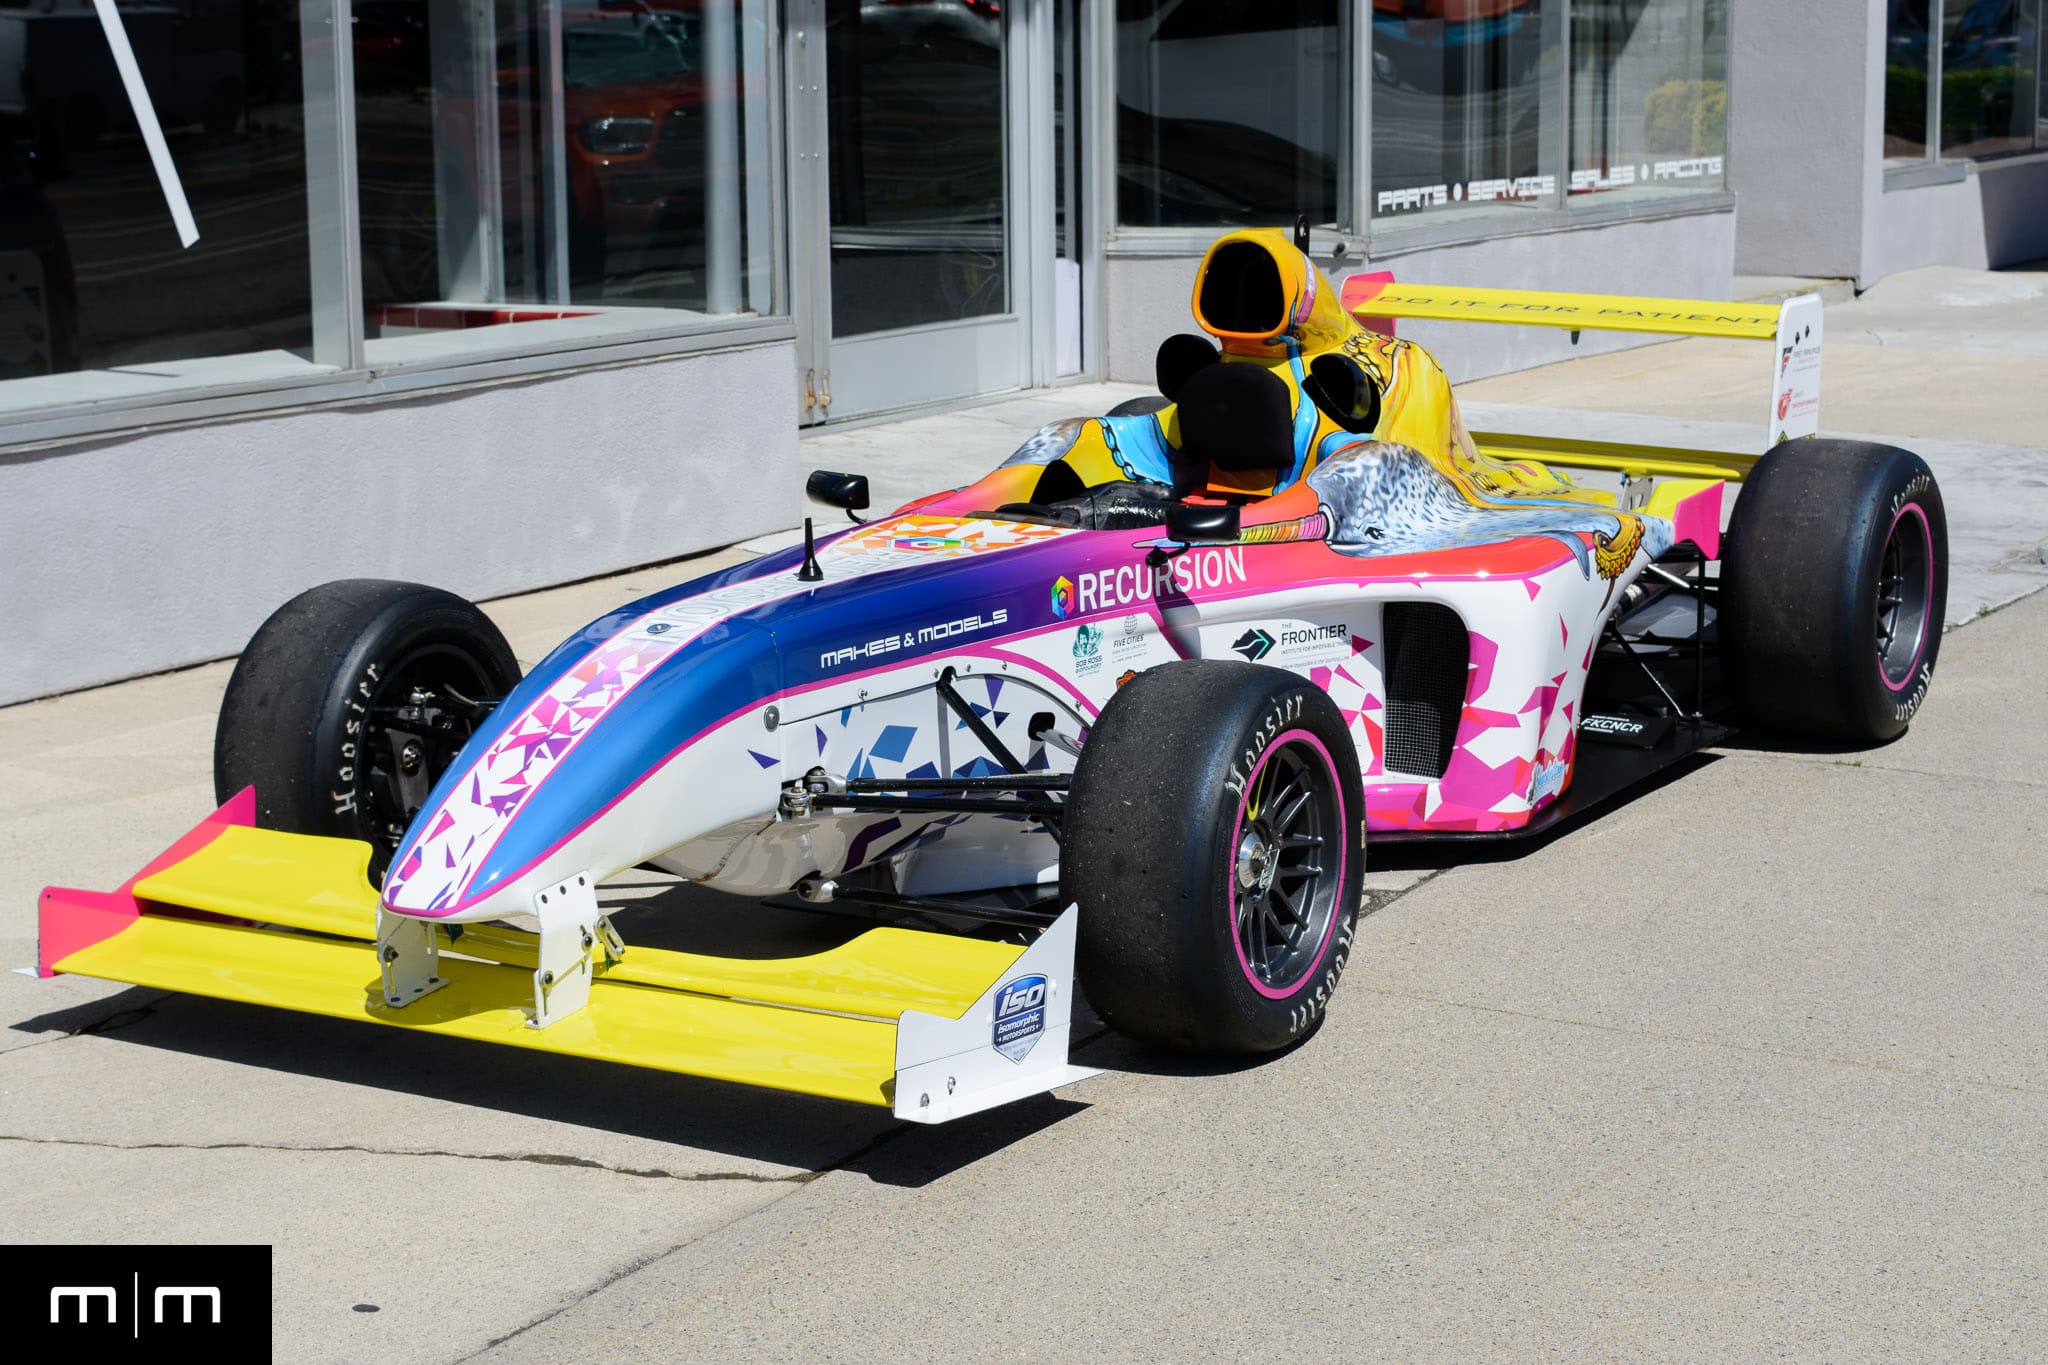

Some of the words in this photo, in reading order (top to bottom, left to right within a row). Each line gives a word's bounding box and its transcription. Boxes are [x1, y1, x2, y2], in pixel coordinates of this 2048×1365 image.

[1571, 165, 1634, 190] SALES
[1653, 157, 1722, 181] RACING
[1378, 184, 1447, 212] PARTS
[1467, 176, 1555, 201] SERVICE
[1378, 296, 1432, 304] DO
[1499, 303, 1580, 313] FOR
[1078, 546, 1247, 612] RECURSION
[820, 635, 900, 669] MAKES
[903, 632, 915, 647] &
[918, 608, 1008, 644] MODELS
[1113, 639, 1126, 648] FIVE
[1126, 633, 1144, 644] CITIES
[1281, 623, 1347, 646] FRONTIER
[1076, 660, 1087, 668] BOB
[1088, 655, 1102, 664] ROSS
[331, 663, 380, 816] Hoosier
[1580, 718, 1644, 733] FKCNCR
[1224, 694, 1303, 800] Hoosier
[998, 983, 1045, 1017] iso
[998, 1011, 1041, 1034] isomorphic
